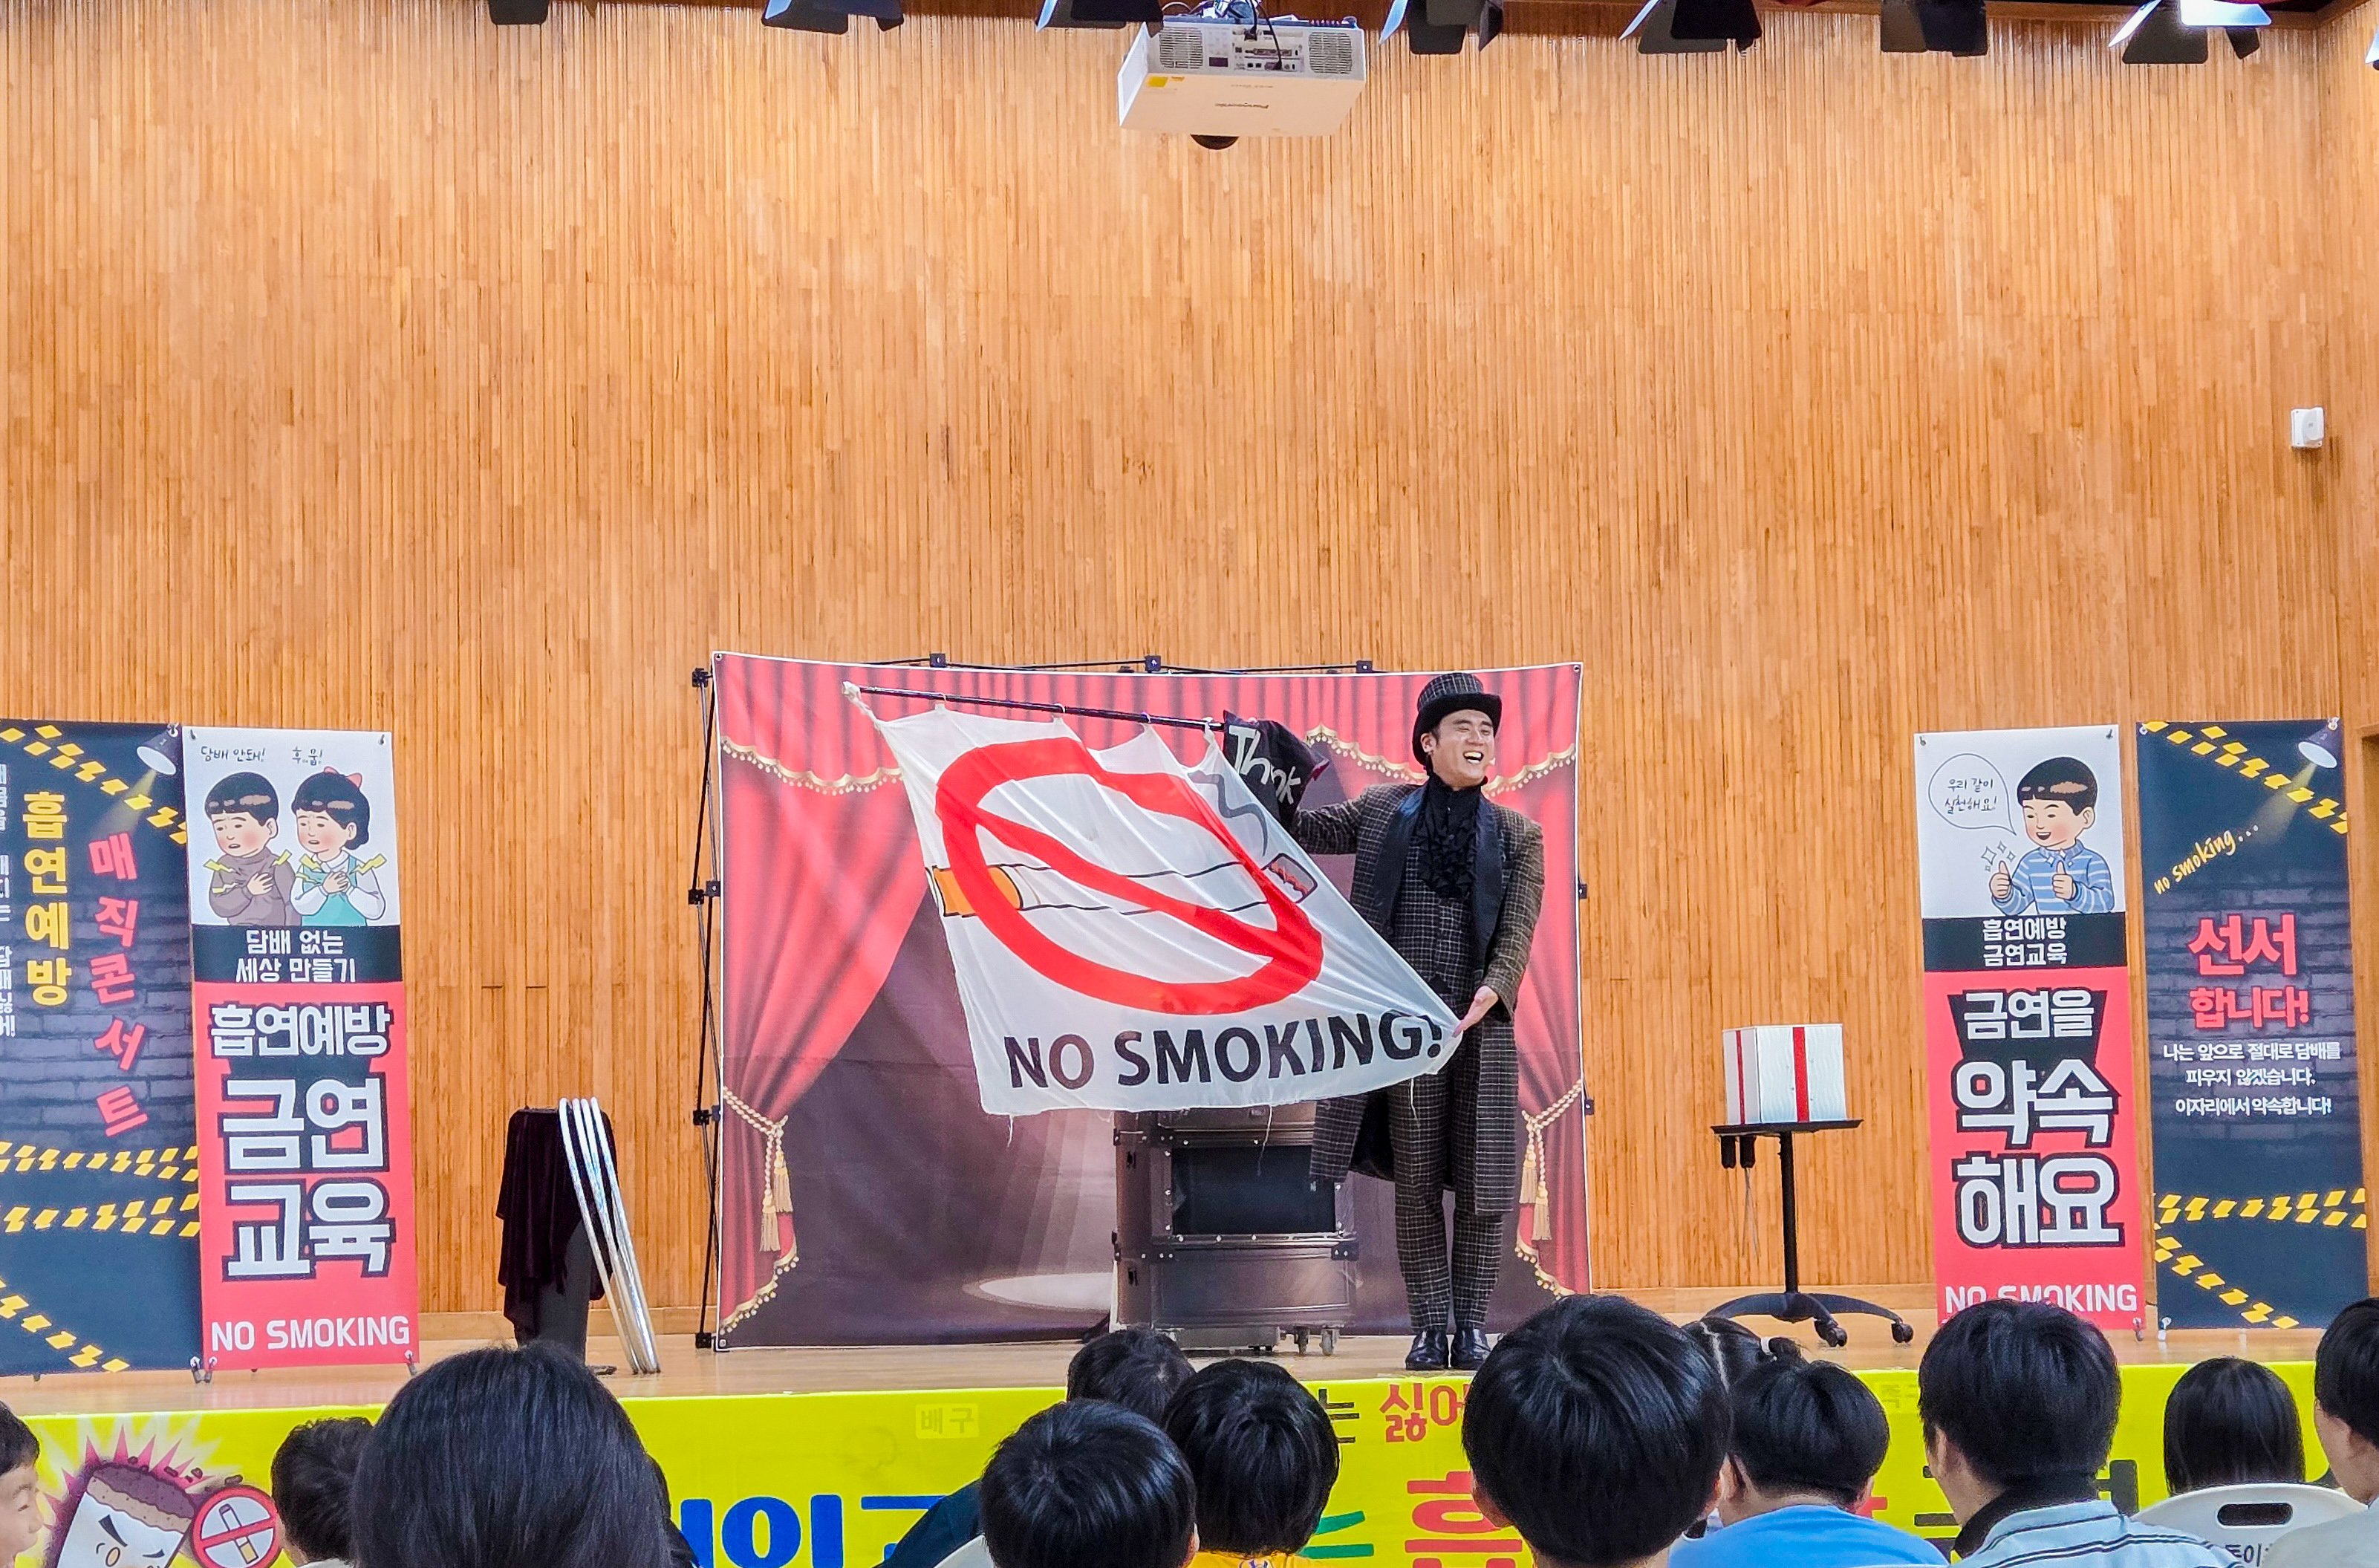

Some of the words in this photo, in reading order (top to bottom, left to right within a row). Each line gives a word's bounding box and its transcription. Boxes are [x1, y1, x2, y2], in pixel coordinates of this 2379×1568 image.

[201, 746, 229, 762] 담배
[233, 747, 266, 762] 안돼!
[1229, 725, 1301, 804] Thnk
[1945, 795, 1997, 815] 실천해요!
[1947, 778, 1968, 793] 우리
[1970, 778, 1994, 793] 같이
[23, 791, 71, 1006] 흡연예방
[2154, 876, 2170, 894] no
[246, 930, 291, 955] 담배
[299, 930, 344, 954] 없는
[1982, 917, 2067, 941] 흡연예방
[2188, 914, 2297, 975] 선서
[236, 957, 281, 983] 세상
[289, 957, 356, 983] 만들기
[1982, 943, 2068, 967] 금연교육
[88, 832, 148, 1136] 매직콘서트
[1964, 989, 2095, 1040] 금연을
[2189, 986, 2310, 1028] 합니다!
[210, 1004, 390, 1057] 흡연예방
[1003, 1033, 1095, 1090] NO
[1113, 1009, 1442, 1087] SMOKING!
[2163, 1043, 2195, 1061] 나는
[2197, 1043, 2245, 1061] 앞으로
[2248, 1042, 2294, 1061] 절대로
[2294, 1041, 2341, 1061] 담배를
[2186, 1068, 2231, 1087] 피우지
[2236, 1067, 2316, 1087] 않겠습니다.
[1956, 1059, 2113, 1145] 약속
[2175, 1096, 2250, 1116] 이자리에서
[2252, 1096, 2332, 1116] 약속합니다!
[223, 1077, 384, 1171] 금연
[1957, 1156, 2119, 1244] 해요
[227, 1182, 390, 1277] 교육
[211, 1321, 255, 1352] NO
[265, 1315, 410, 1350] SMOKING
